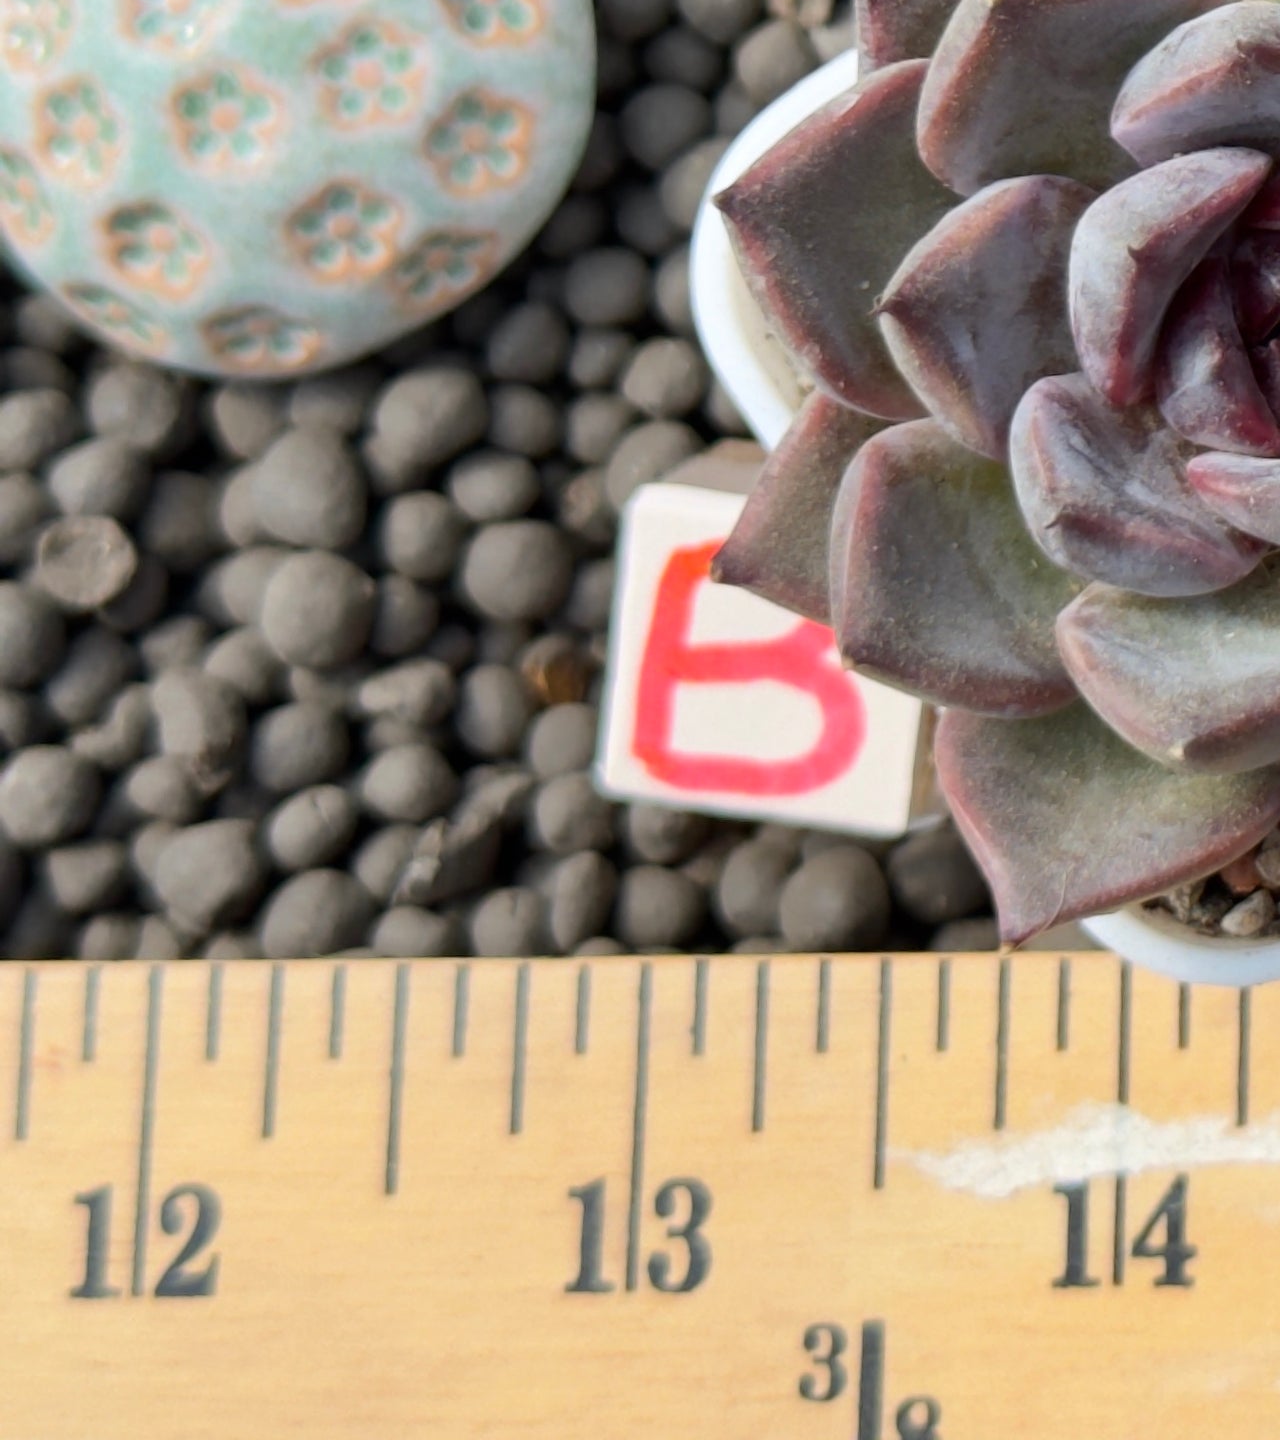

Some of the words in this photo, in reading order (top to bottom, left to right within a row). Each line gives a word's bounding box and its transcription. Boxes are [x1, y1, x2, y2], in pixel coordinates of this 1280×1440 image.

[632, 538, 868, 799] B
[68, 1181, 222, 1299] 12
[565, 1176, 714, 1294] 13
[1052, 1171, 1197, 1288] 14
